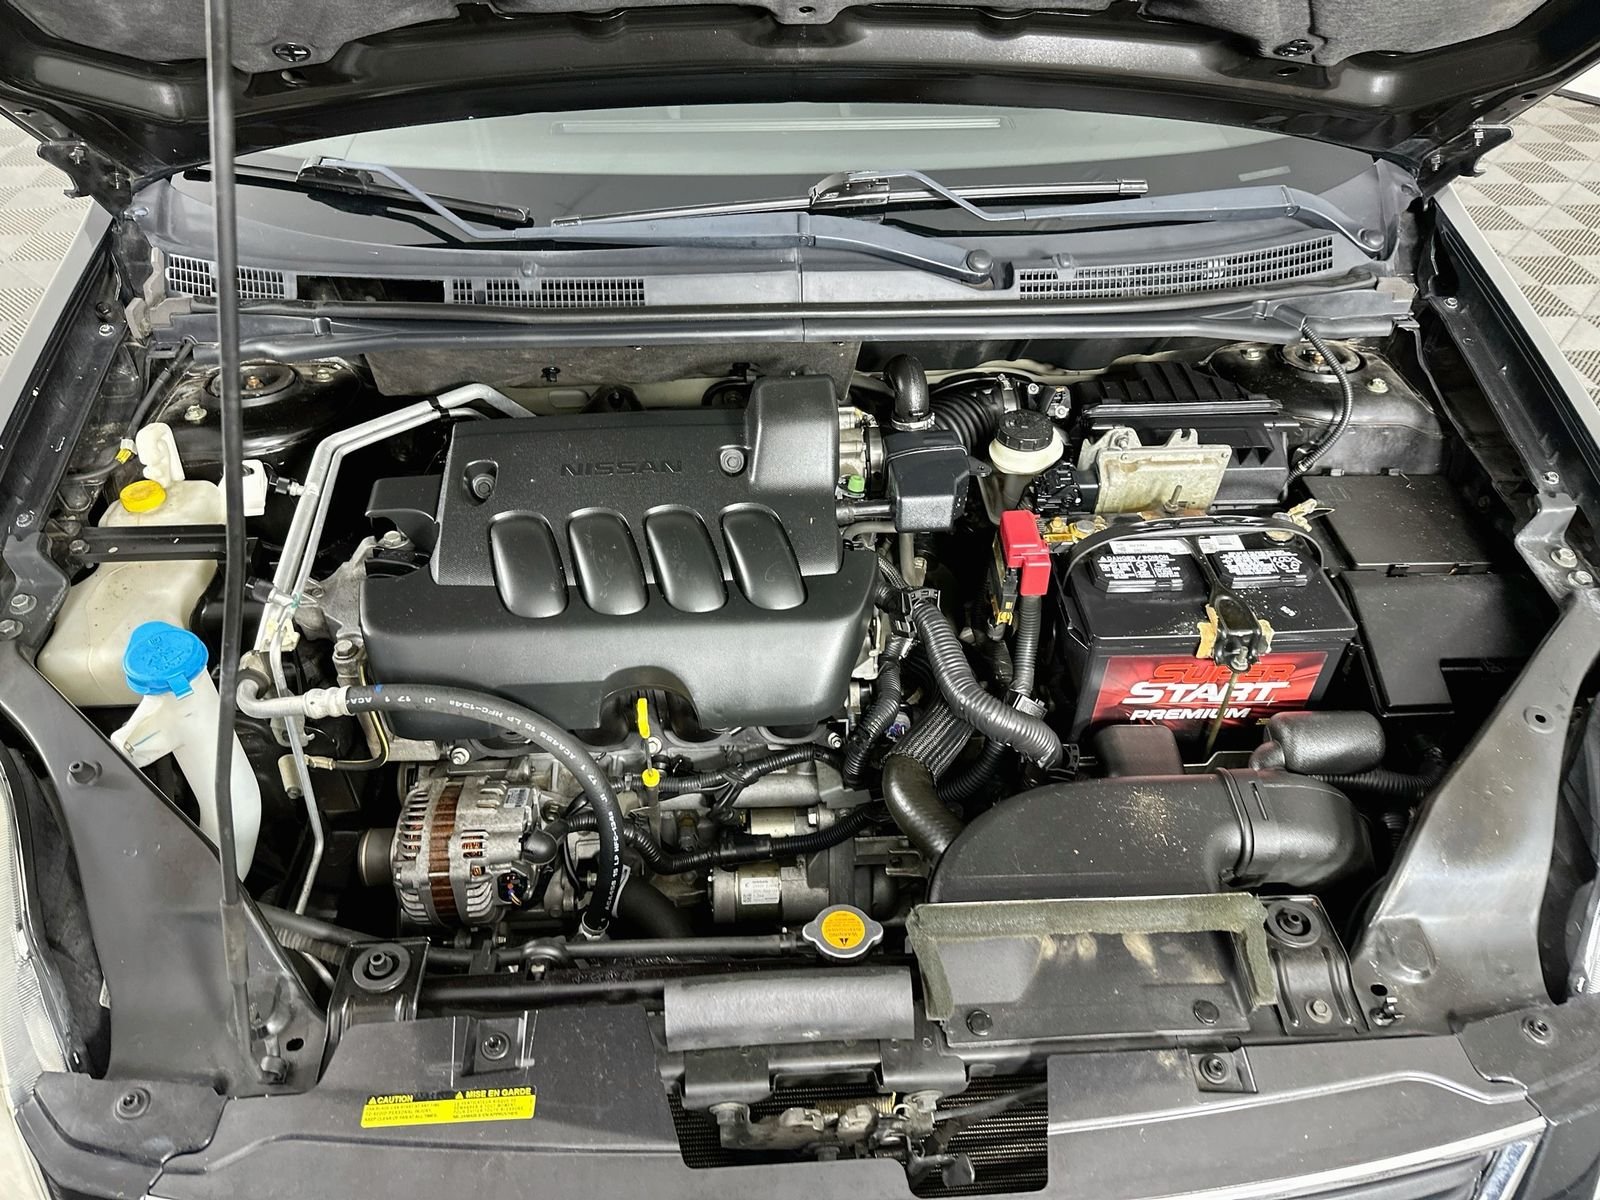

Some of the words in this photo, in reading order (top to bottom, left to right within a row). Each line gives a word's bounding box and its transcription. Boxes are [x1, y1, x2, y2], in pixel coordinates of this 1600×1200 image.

[560, 460, 682, 477] NISSAN
[1149, 663, 1296, 683] SUPER
[1122, 681, 1291, 705] START
[506, 716, 521, 725] LP
[1130, 707, 1251, 721] PREMIUM
[377, 1094, 414, 1104] CAUTION
[465, 1090, 487, 1098] MISE
[488, 1089, 500, 1097] EN
[501, 1087, 531, 1096] GARDE
